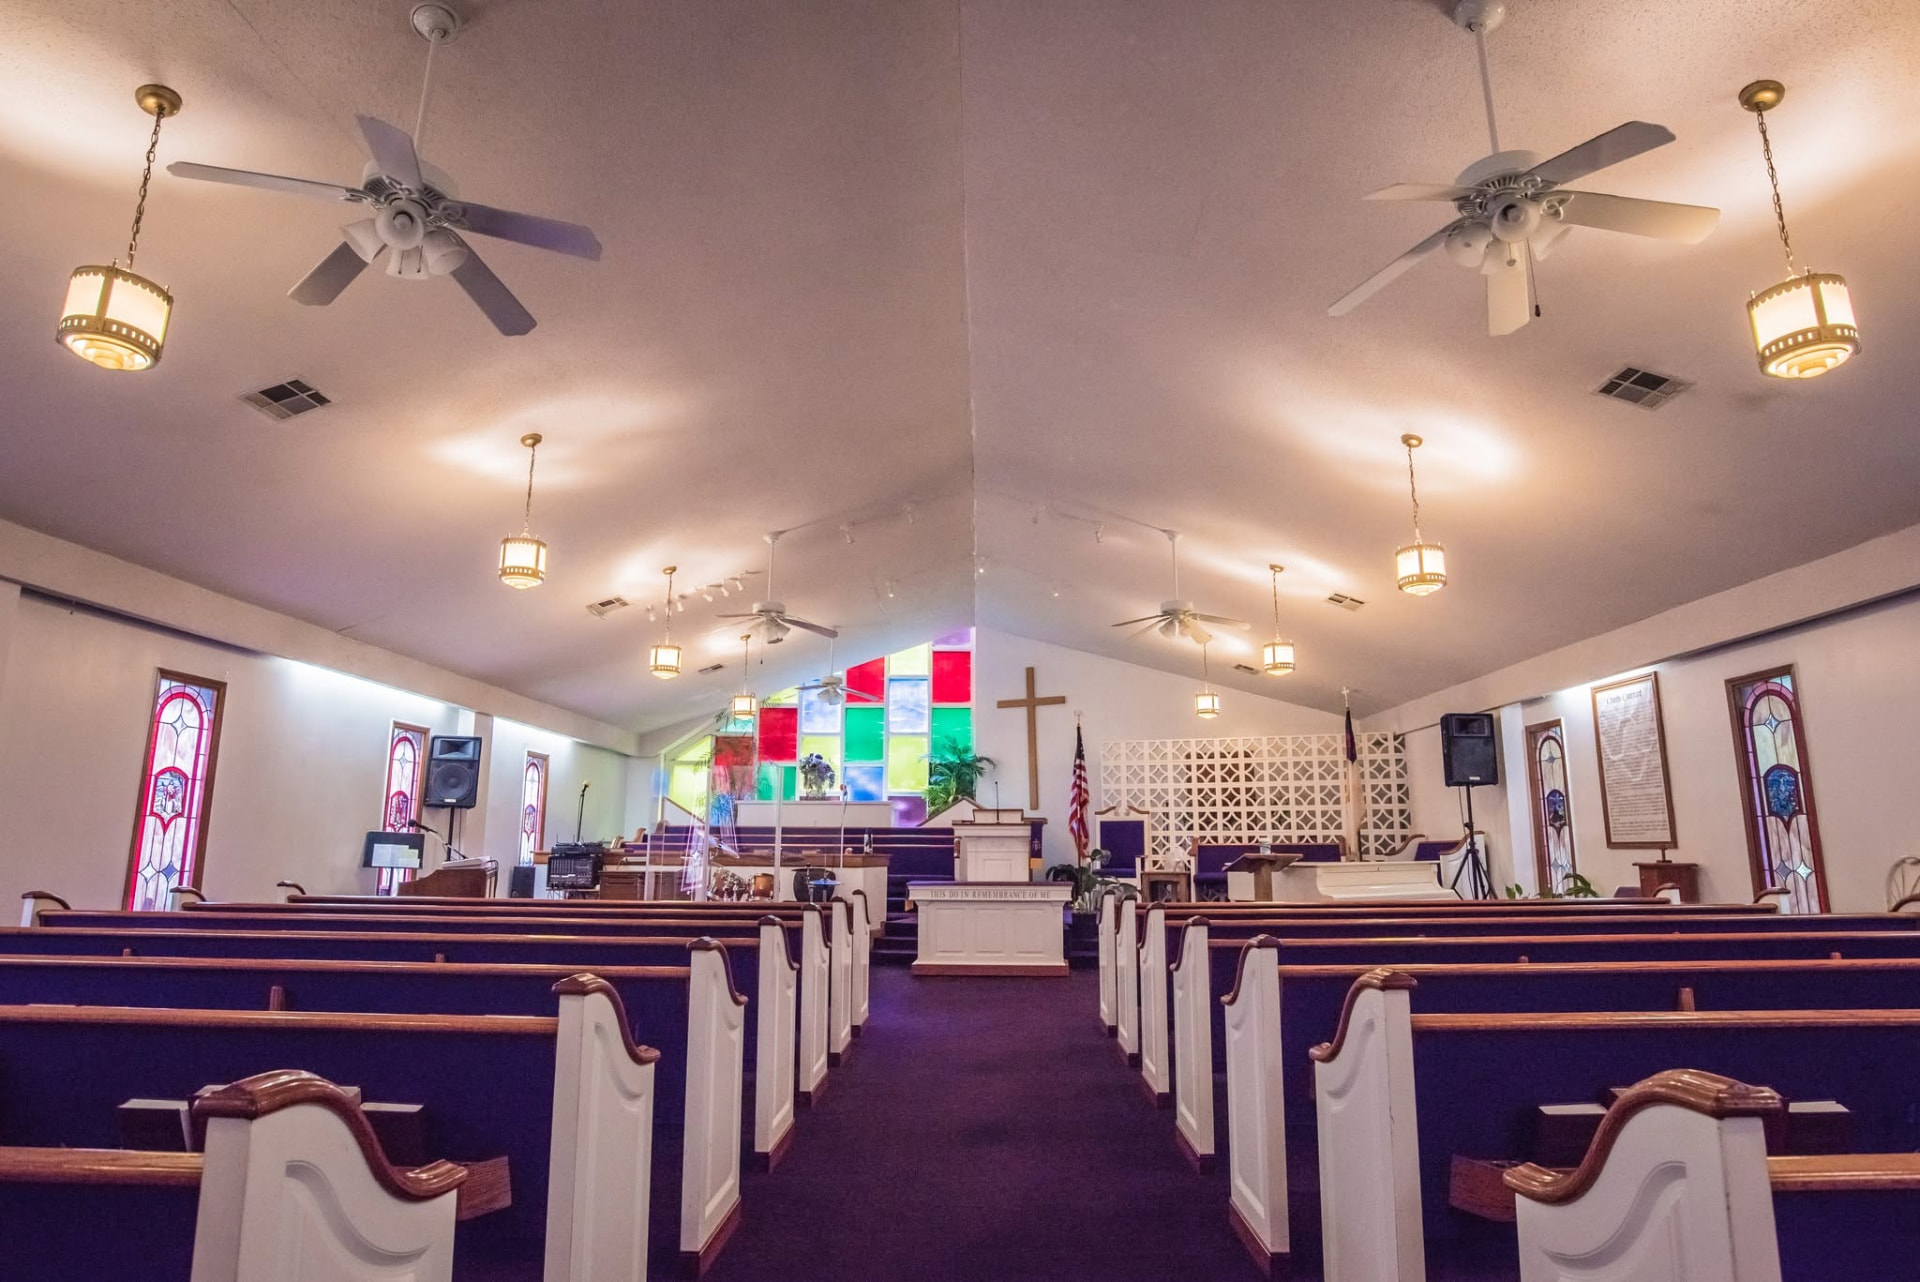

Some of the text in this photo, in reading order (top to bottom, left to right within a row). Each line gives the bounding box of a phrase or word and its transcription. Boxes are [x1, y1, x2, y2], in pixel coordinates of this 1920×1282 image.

[930, 890, 1050, 898] THIS DO IN REMEMBRANCE OF ME
